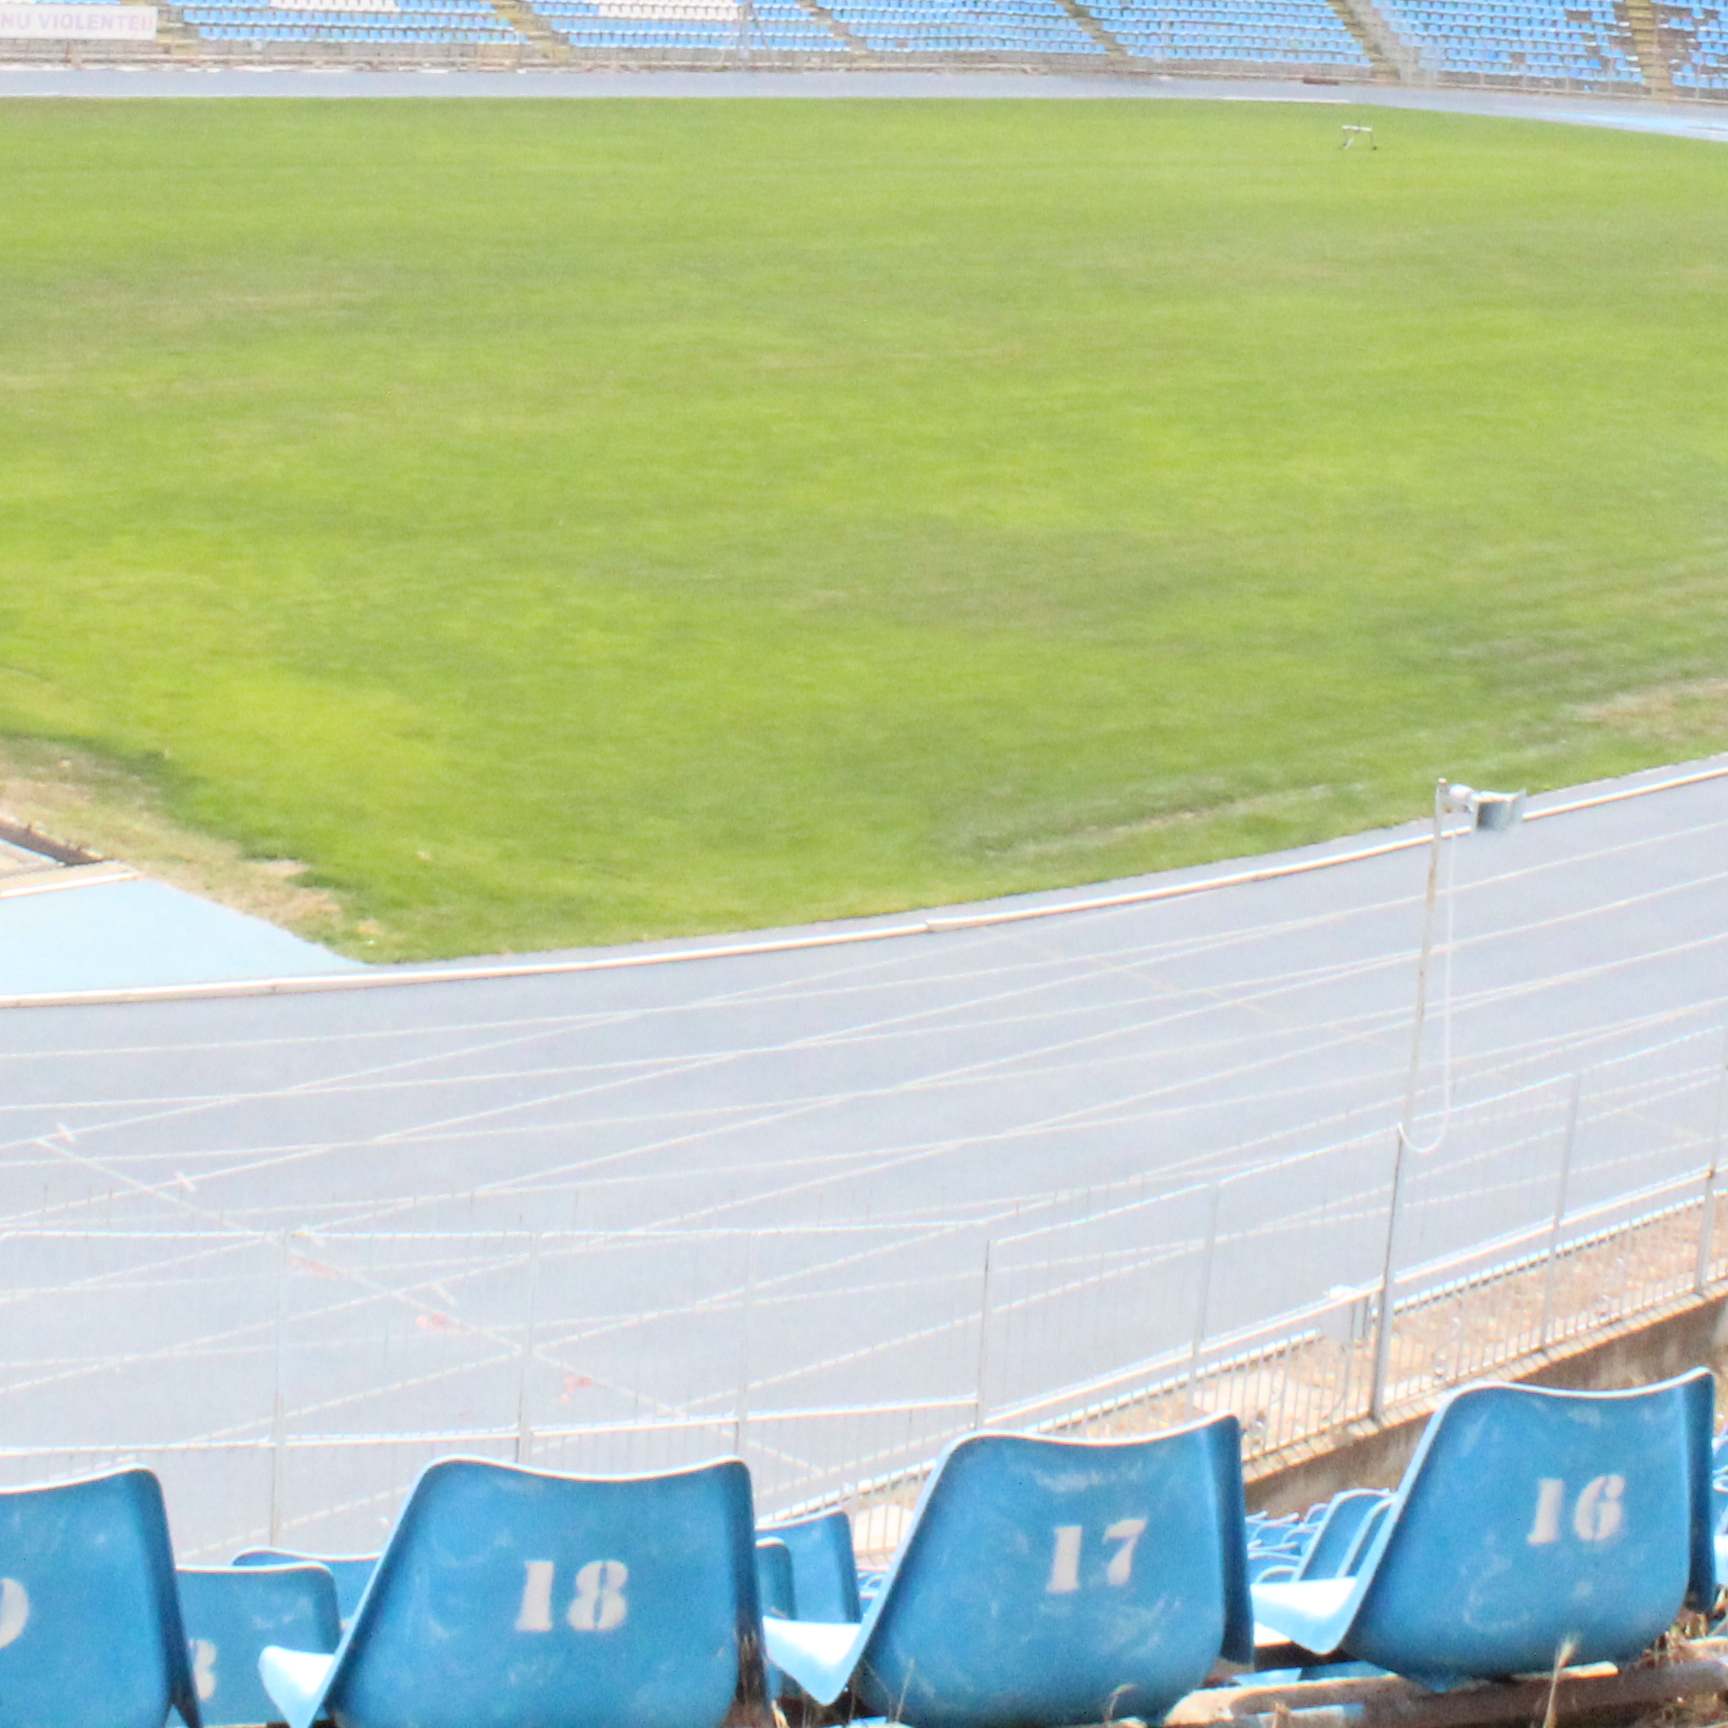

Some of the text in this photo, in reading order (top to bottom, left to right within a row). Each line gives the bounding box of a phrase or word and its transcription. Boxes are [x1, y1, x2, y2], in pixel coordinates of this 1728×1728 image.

[0, 11, 30, 30] NU
[1526, 1473, 1626, 1546] 16
[1045, 1517, 1149, 1594] 17
[514, 1558, 630, 1633] 18
